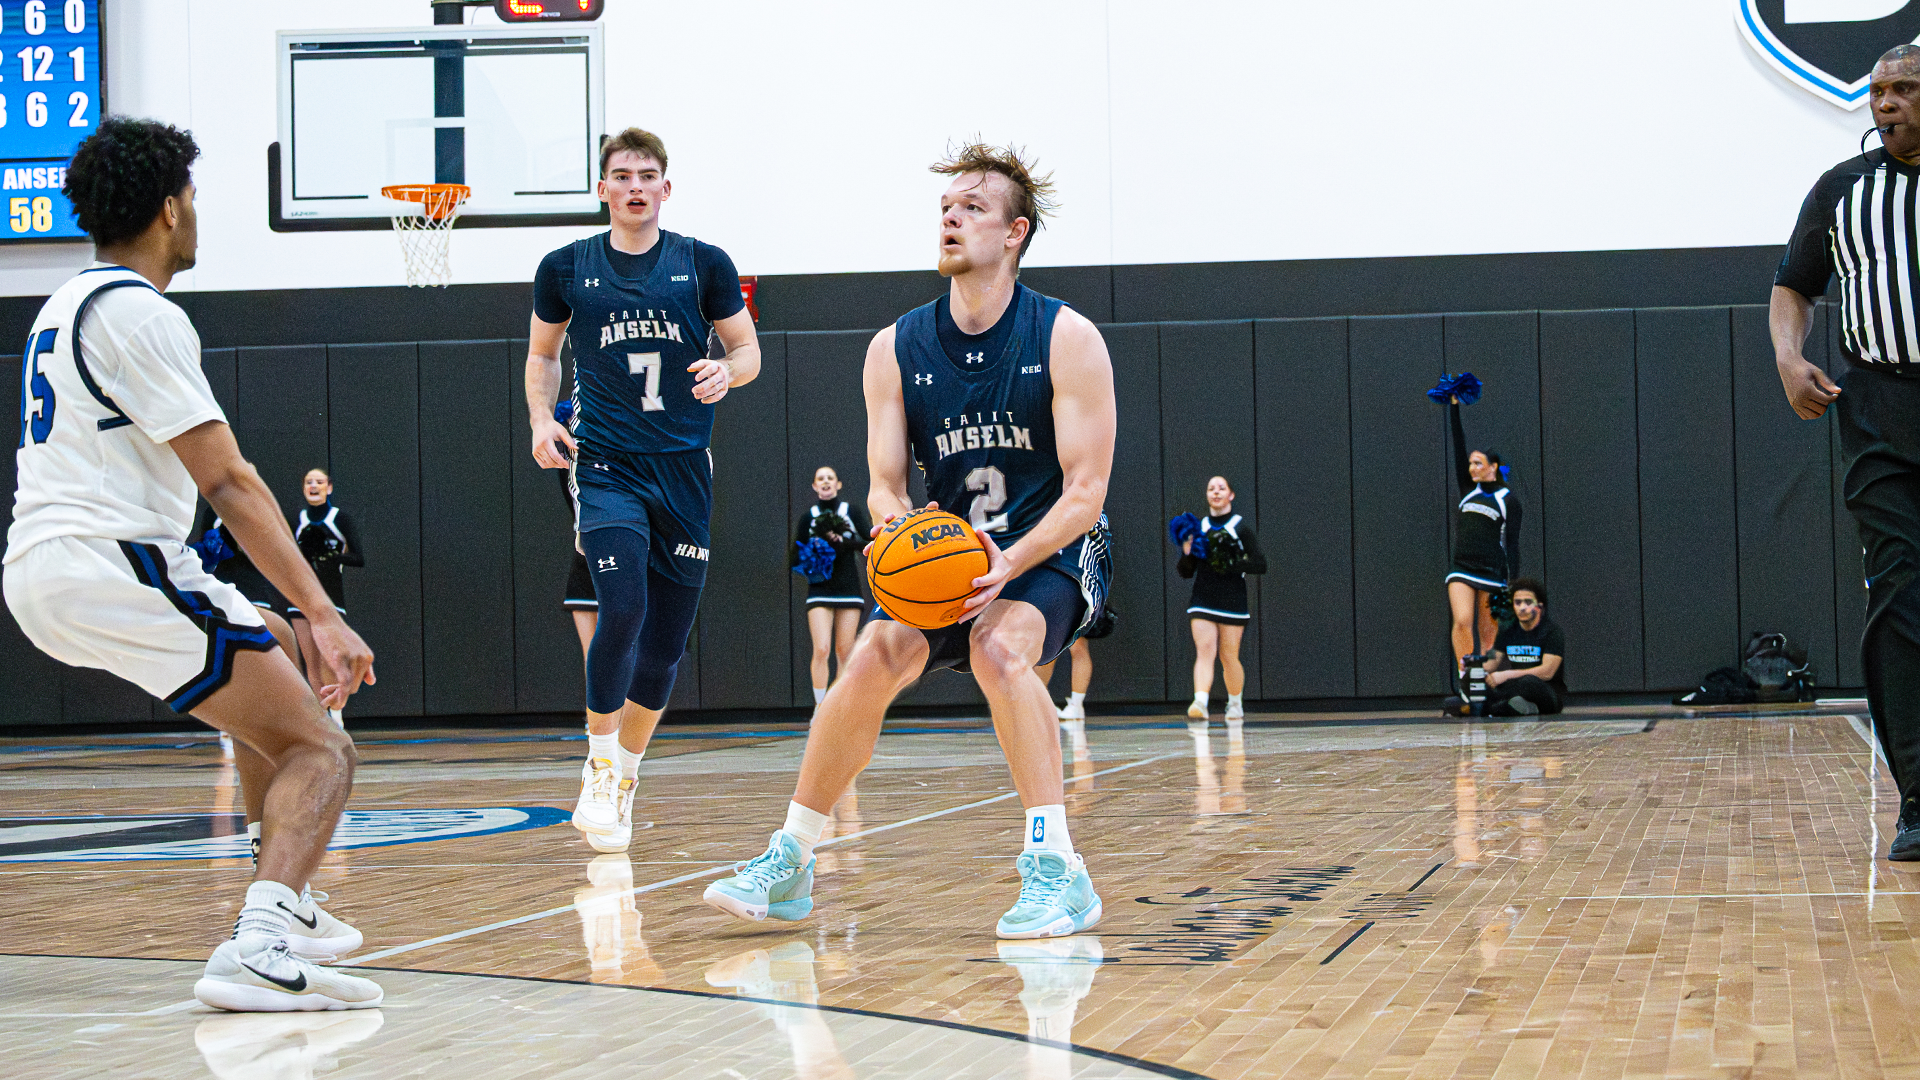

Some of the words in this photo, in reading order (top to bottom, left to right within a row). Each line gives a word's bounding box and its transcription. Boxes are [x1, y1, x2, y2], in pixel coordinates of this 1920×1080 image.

[25, 0, 46, 35] 6
[64, 0, 85, 33] 0
[17, 46, 54, 81] 12
[68, 47, 85, 81] 1
[26, 92, 48, 127] 6
[68, 92, 89, 127] 2
[9, 197, 53, 232] 58
[609, 309, 667, 322] SAINT
[600, 320, 684, 349] ANSELM
[627, 352, 666, 412] 7
[1021, 364, 1042, 375] NE10
[944, 411, 1013, 429] SAINT
[934, 425, 1035, 461] ANSELM
[964, 465, 1010, 533] 2
[911, 523, 967, 550] NCAA
